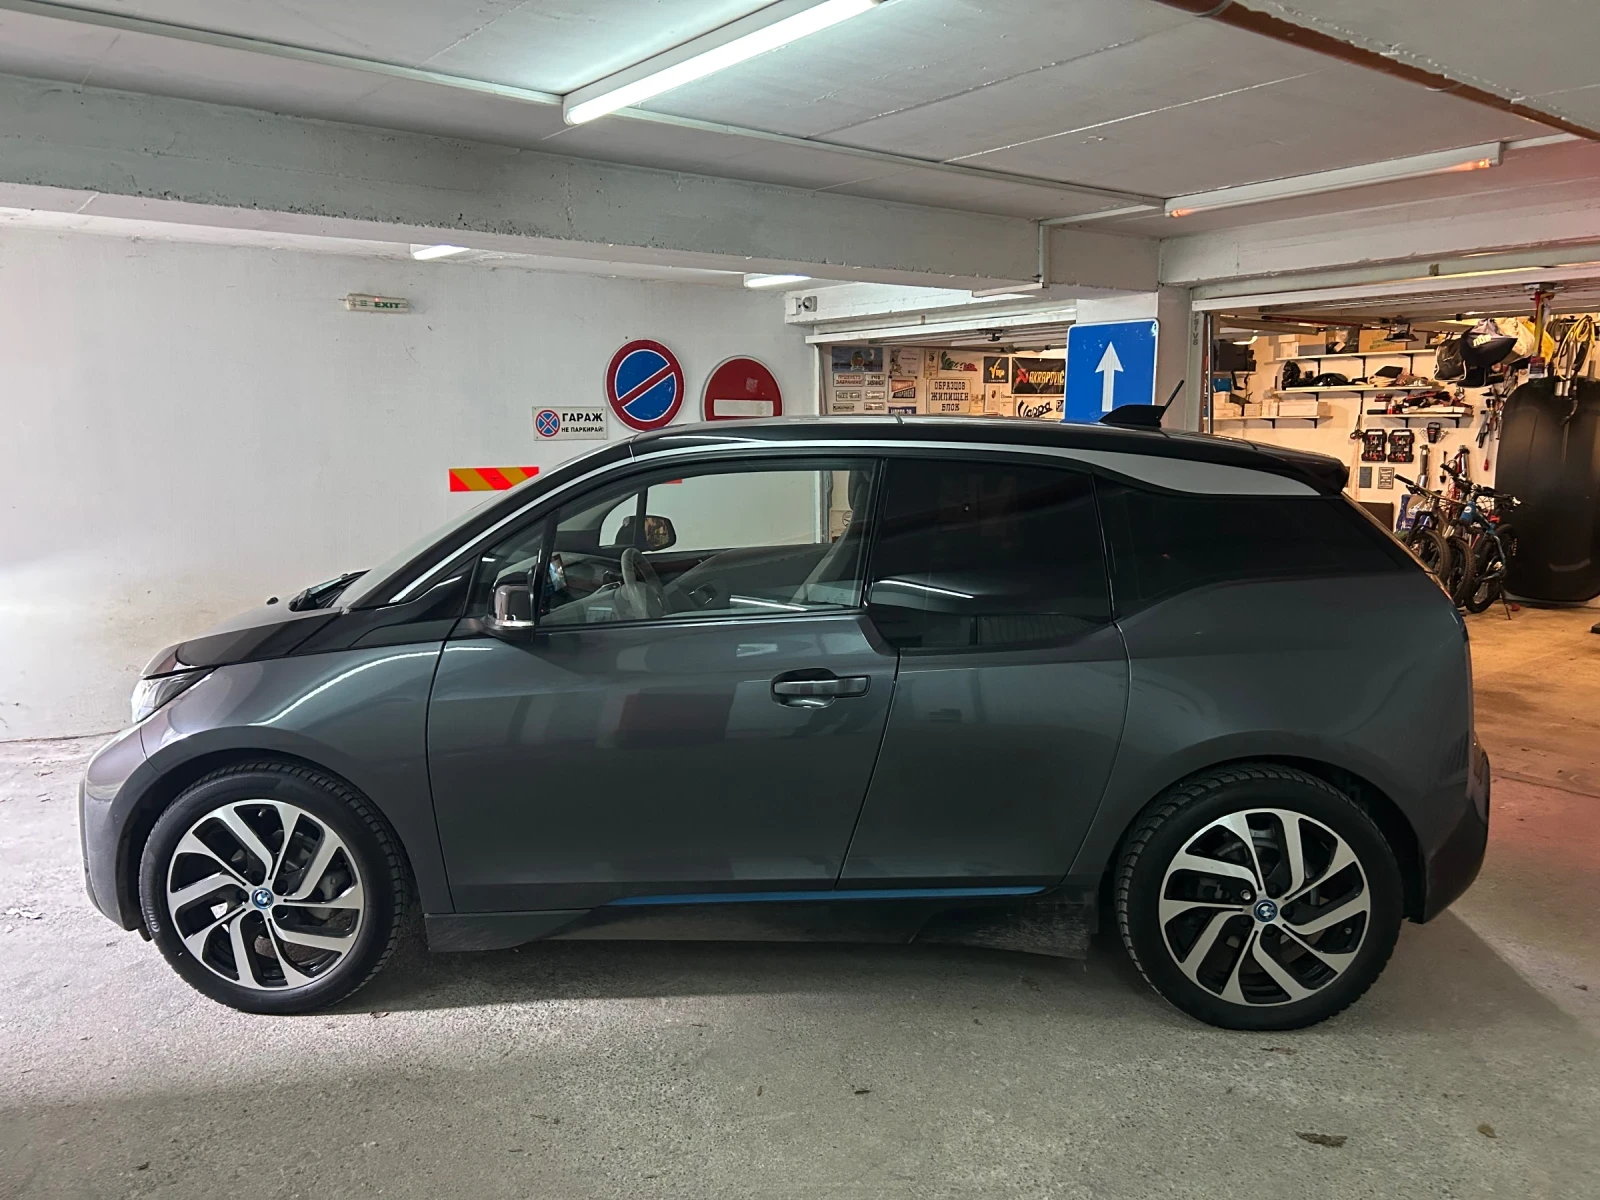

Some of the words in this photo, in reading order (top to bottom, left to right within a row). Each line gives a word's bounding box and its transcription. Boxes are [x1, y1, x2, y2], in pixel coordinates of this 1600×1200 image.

[934, 381, 966, 391] ОБРАЗЦОВ
[930, 392, 969, 401] ЖИЛИЩЕН
[941, 403, 960, 411] БЛОК
[562, 413, 603, 422] ГАРАЖ
